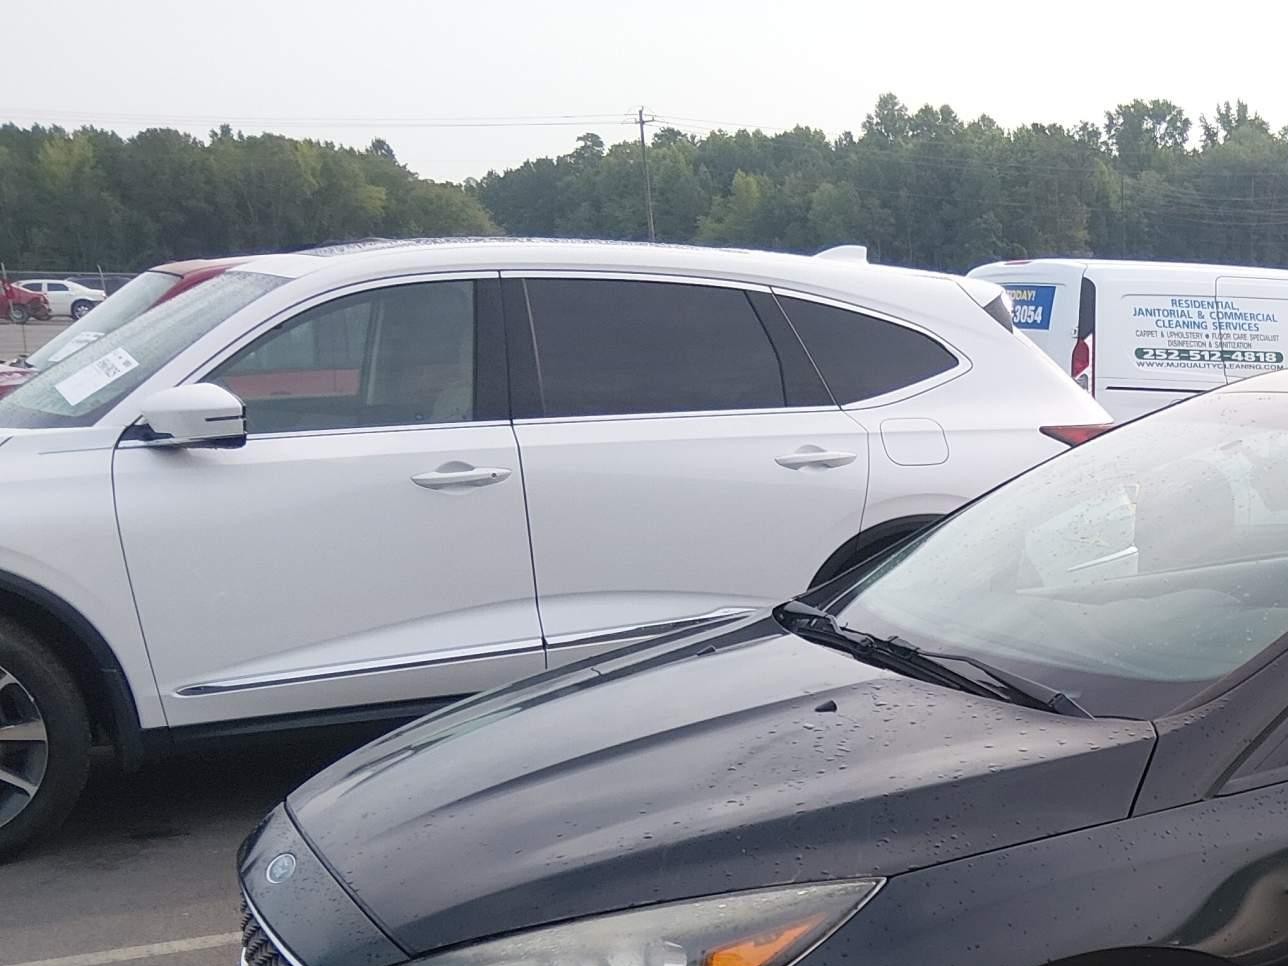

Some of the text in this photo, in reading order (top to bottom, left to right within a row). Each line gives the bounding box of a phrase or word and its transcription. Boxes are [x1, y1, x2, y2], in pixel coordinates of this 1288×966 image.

[1171, 298, 1240, 311] RESIDENTIAL,
[1133, 307, 1278, 323] JANITORIAL & COMMERCIAL
[1155, 319, 1260, 332] CLEANING SERVICES
[1135, 330, 1158, 338] CARPET
[1167, 331, 1204, 340] UPHOLSTERY
[1250, 334, 1279, 342] SPECIALIST
[1167, 339, 1207, 348] DISINFECTION
[1214, 341, 1252, 349] SANITIZATION
[1143, 349, 1277, 362] 252-512-4818
